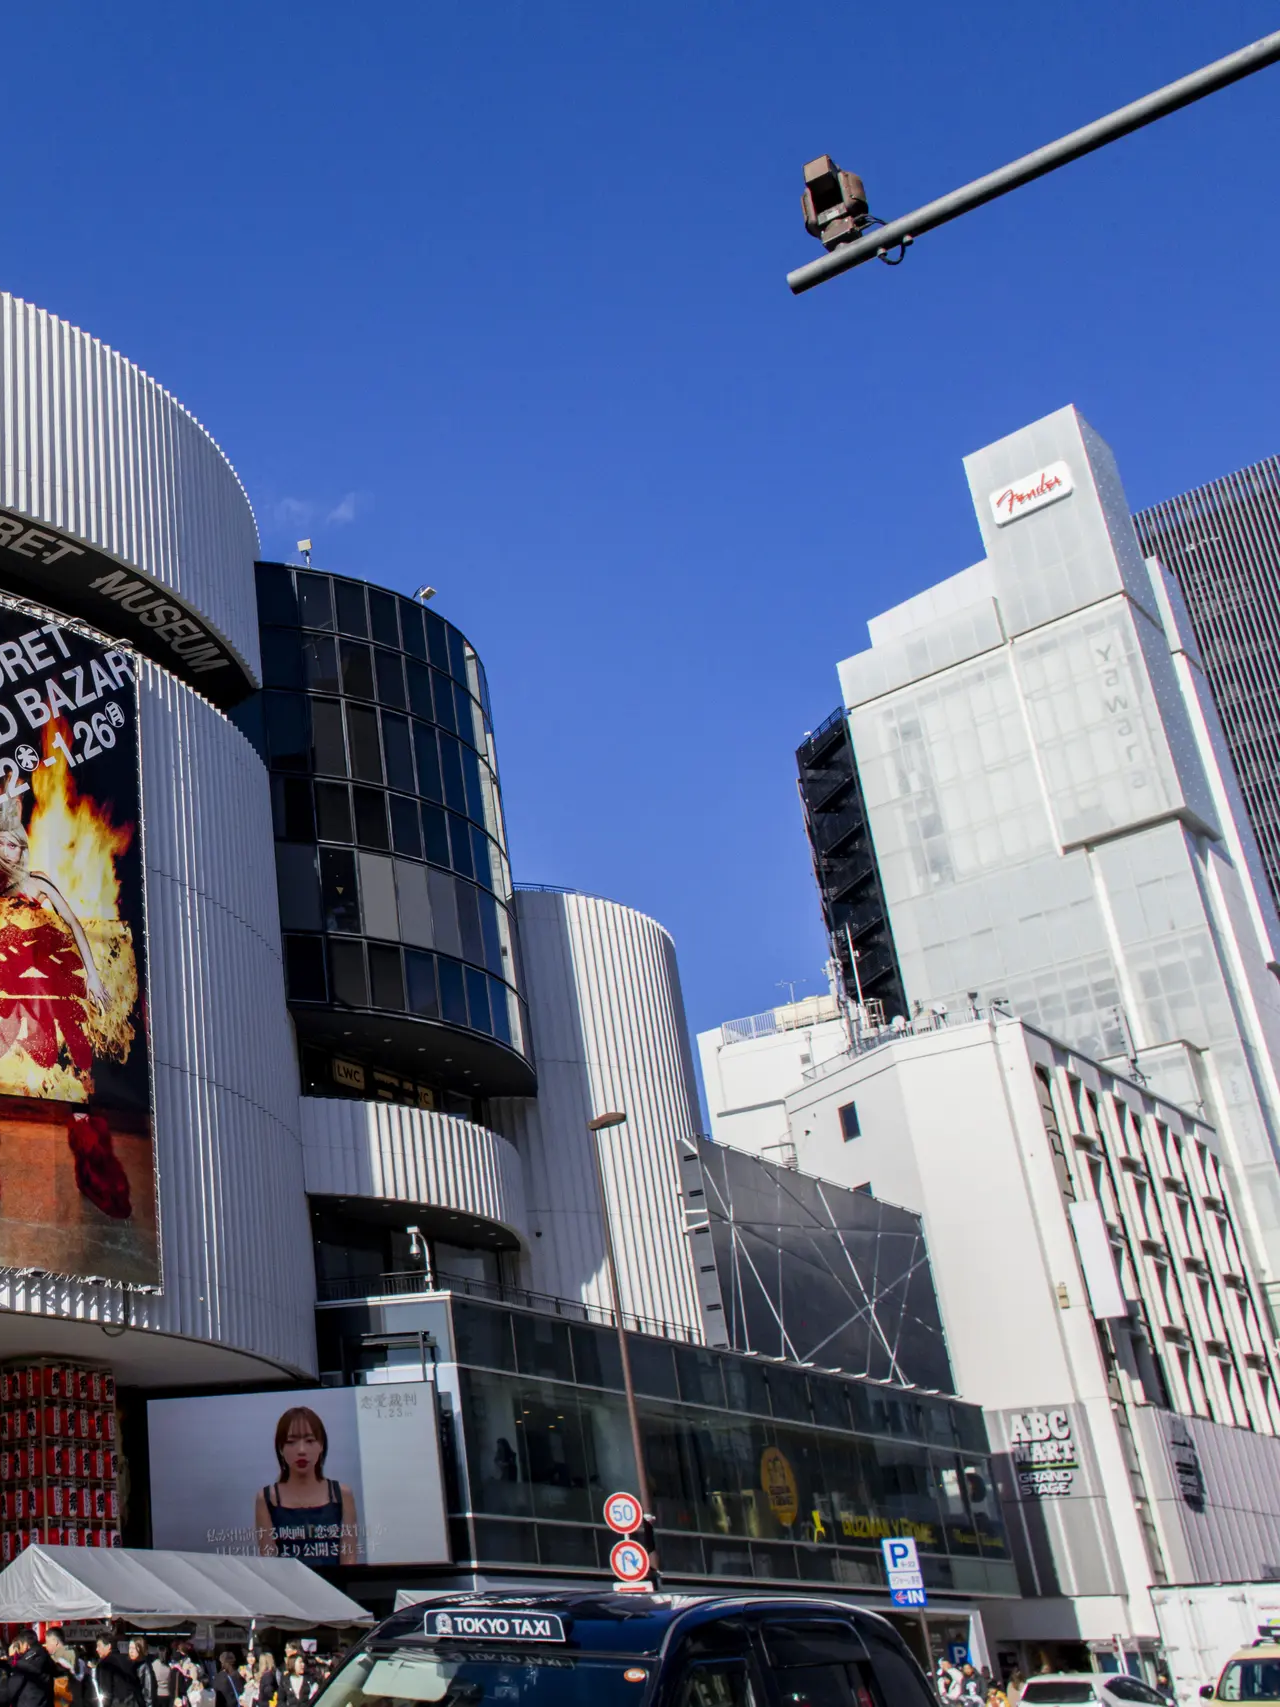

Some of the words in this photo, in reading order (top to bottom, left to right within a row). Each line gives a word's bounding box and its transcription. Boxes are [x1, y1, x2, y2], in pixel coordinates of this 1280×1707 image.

[997, 473, 1061, 513] Fender
[89, 570, 229, 673] MUSEUM
[16, 649, 136, 730] BAZAR
[336, 1065, 361, 1083] LWC
[1011, 1410, 1071, 1442] ABC
[1011, 1440, 1076, 1462] MART
[1018, 1470, 1073, 1484] GRAND
[1021, 1482, 1070, 1495] STAGE
[612, 1504, 634, 1522] 50
[889, 1543, 908, 1568] P
[907, 1590, 925, 1604] IN
[453, 1616, 510, 1635] TOKYO
[511, 1619, 551, 1636] TAXI
[953, 1646, 968, 1664] P
